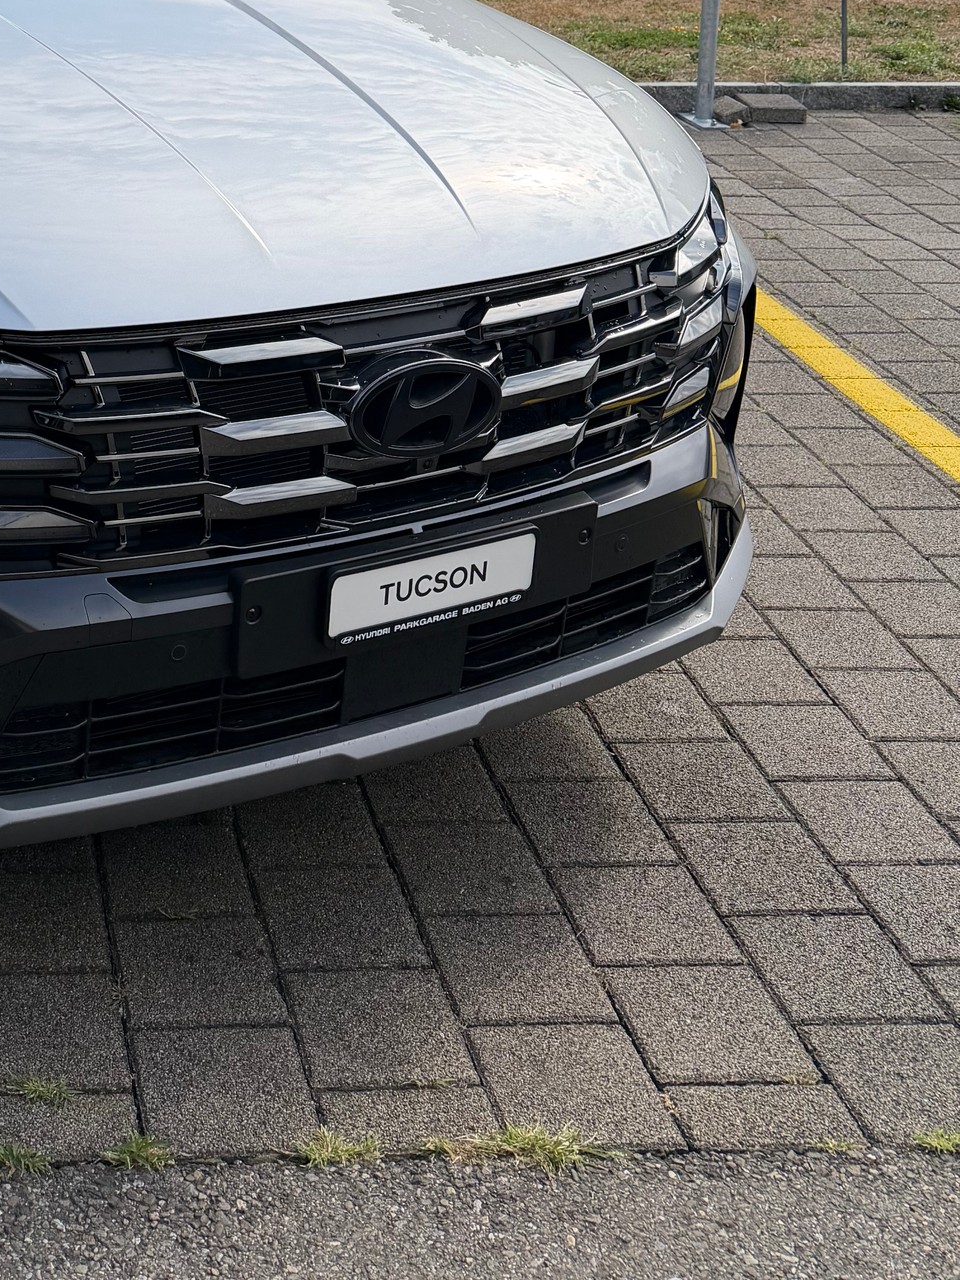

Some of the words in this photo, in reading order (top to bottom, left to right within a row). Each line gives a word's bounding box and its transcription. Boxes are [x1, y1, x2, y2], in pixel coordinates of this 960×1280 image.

[379, 560, 488, 606] TUCSON
[355, 626, 391, 642] HYUNDAI
[393, 609, 459, 633] PARKGARAGE
[462, 600, 494, 616] BADEN
[495, 596, 509, 607] AG
